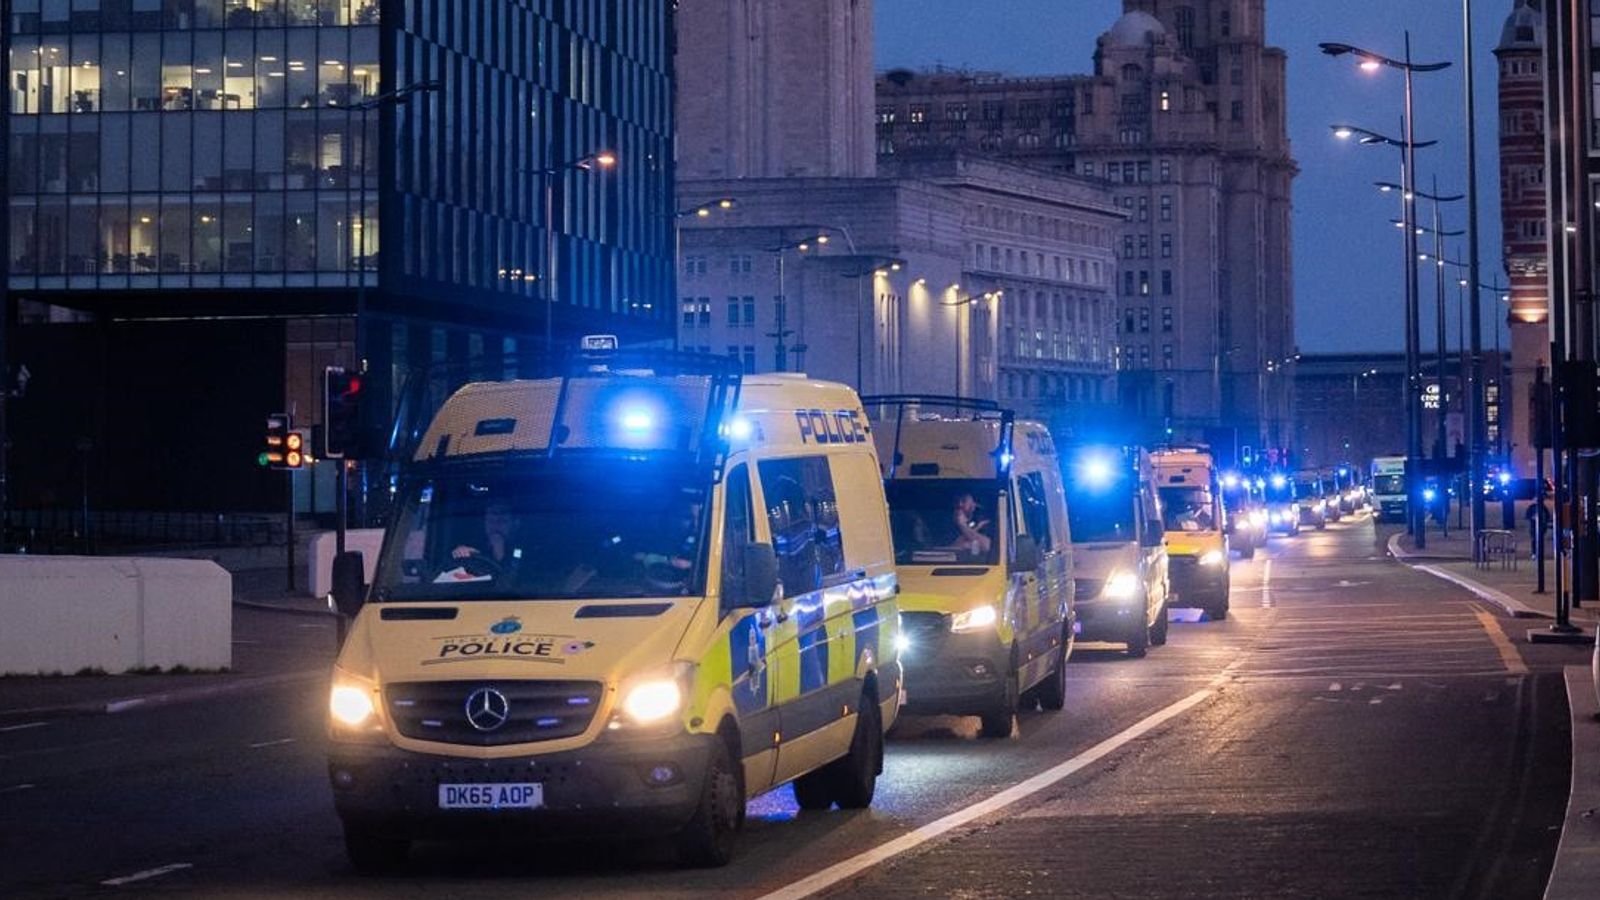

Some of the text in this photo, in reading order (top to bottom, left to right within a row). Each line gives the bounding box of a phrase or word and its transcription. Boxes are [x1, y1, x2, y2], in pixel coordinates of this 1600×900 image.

[795, 408, 866, 444] POLICE
[439, 641, 554, 657] POLICE
[446, 786, 534, 805] DK65 AOP
